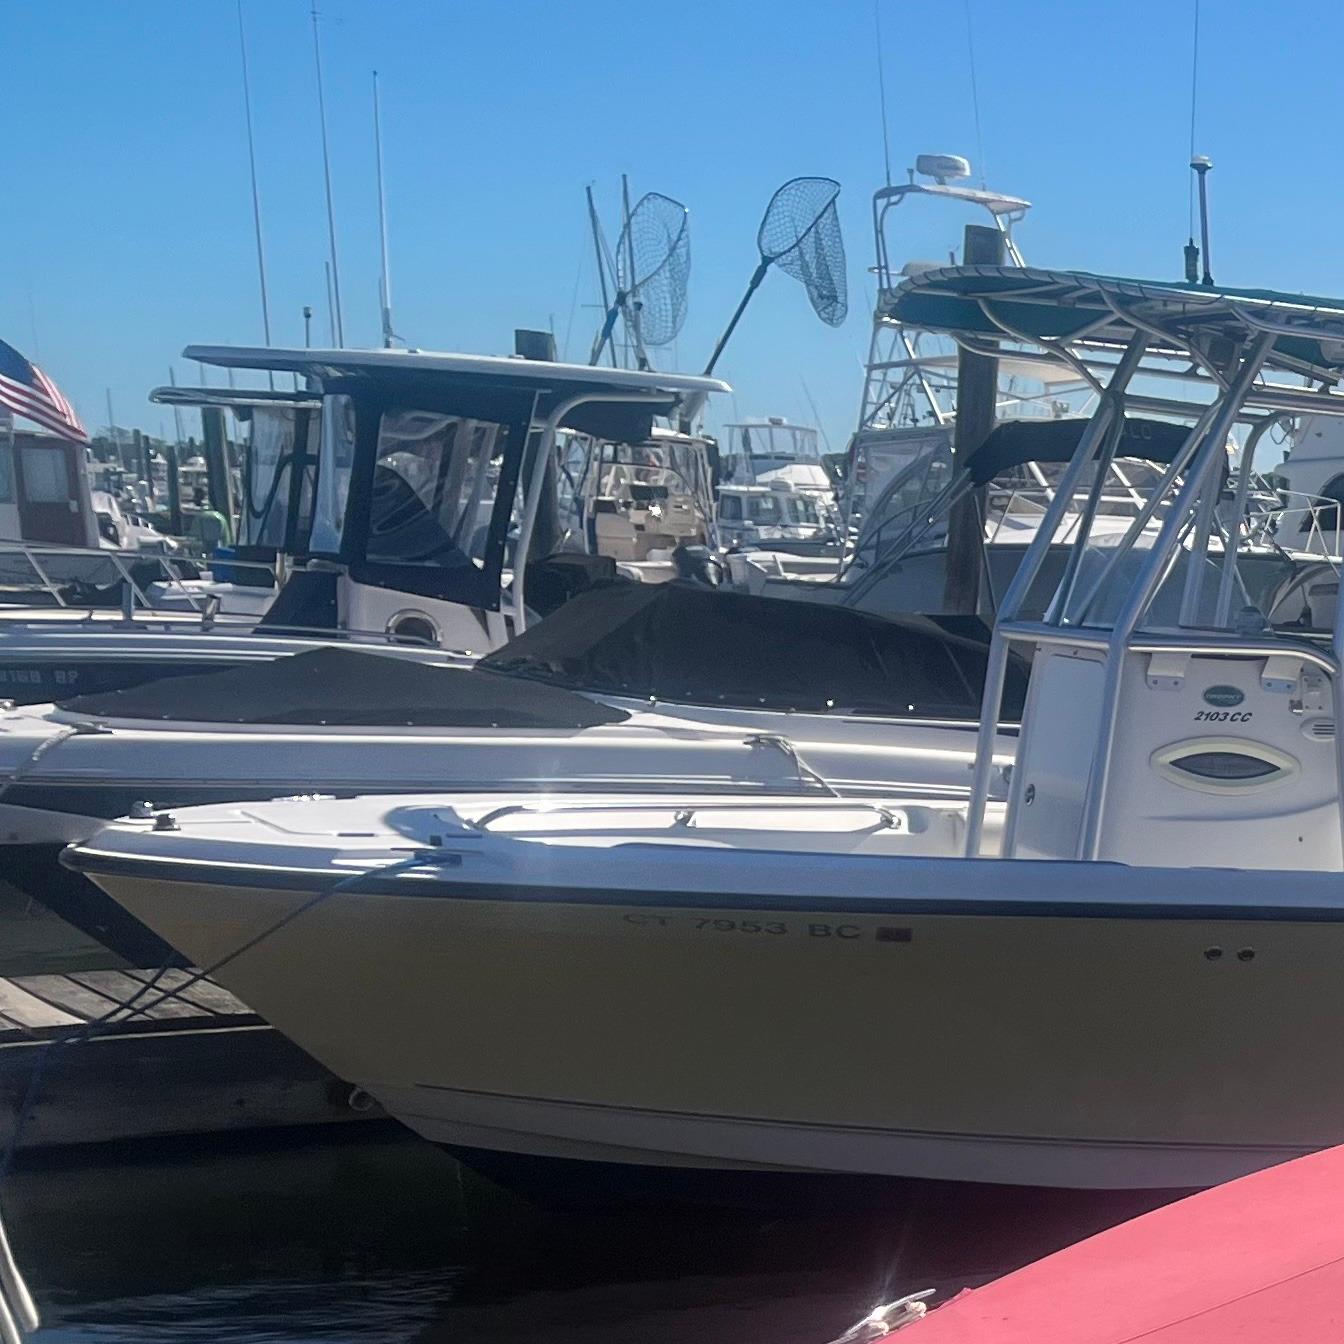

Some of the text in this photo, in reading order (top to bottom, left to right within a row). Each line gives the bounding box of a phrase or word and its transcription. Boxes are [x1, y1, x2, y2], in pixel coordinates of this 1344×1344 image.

[623, 913, 673, 927] CT
[689, 917, 789, 936] 7953
[807, 923, 861, 940] BC
